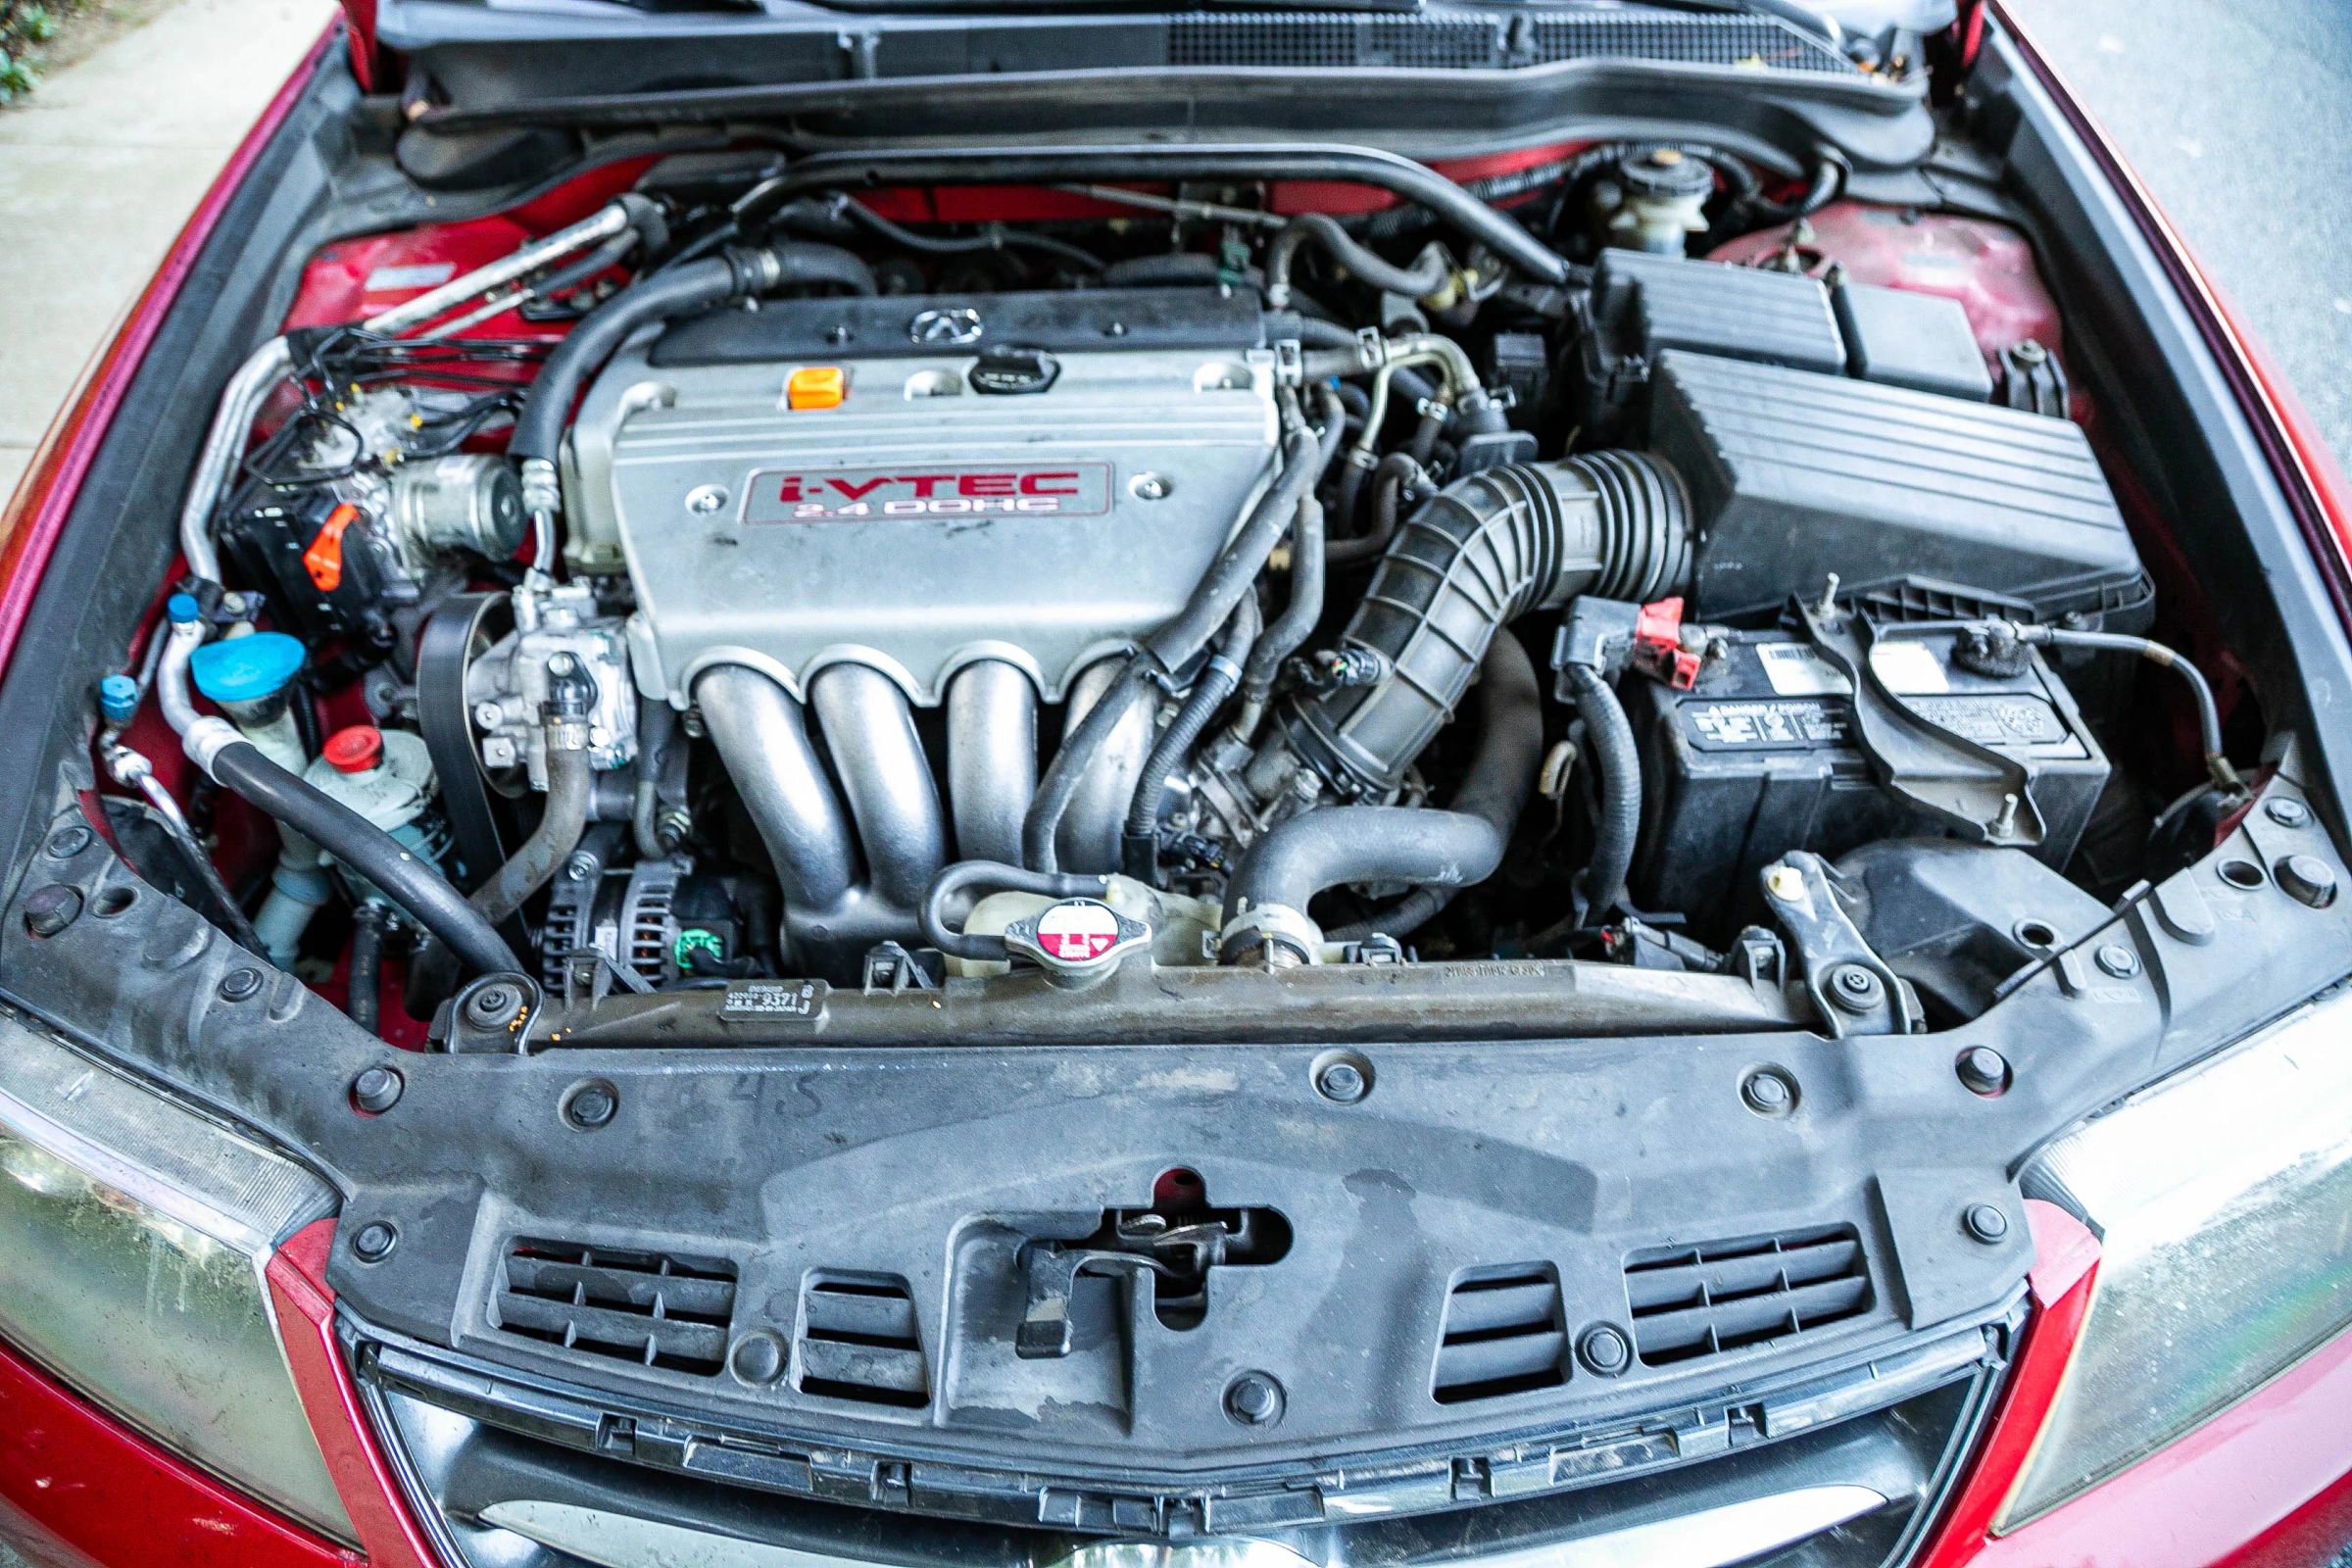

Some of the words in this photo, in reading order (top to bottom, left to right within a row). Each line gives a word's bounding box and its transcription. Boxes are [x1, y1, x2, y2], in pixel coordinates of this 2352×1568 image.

[780, 472, 1079, 502] i-VTEC
[793, 502, 871, 517] 2.4
[883, 498, 1060, 514] DOHC
